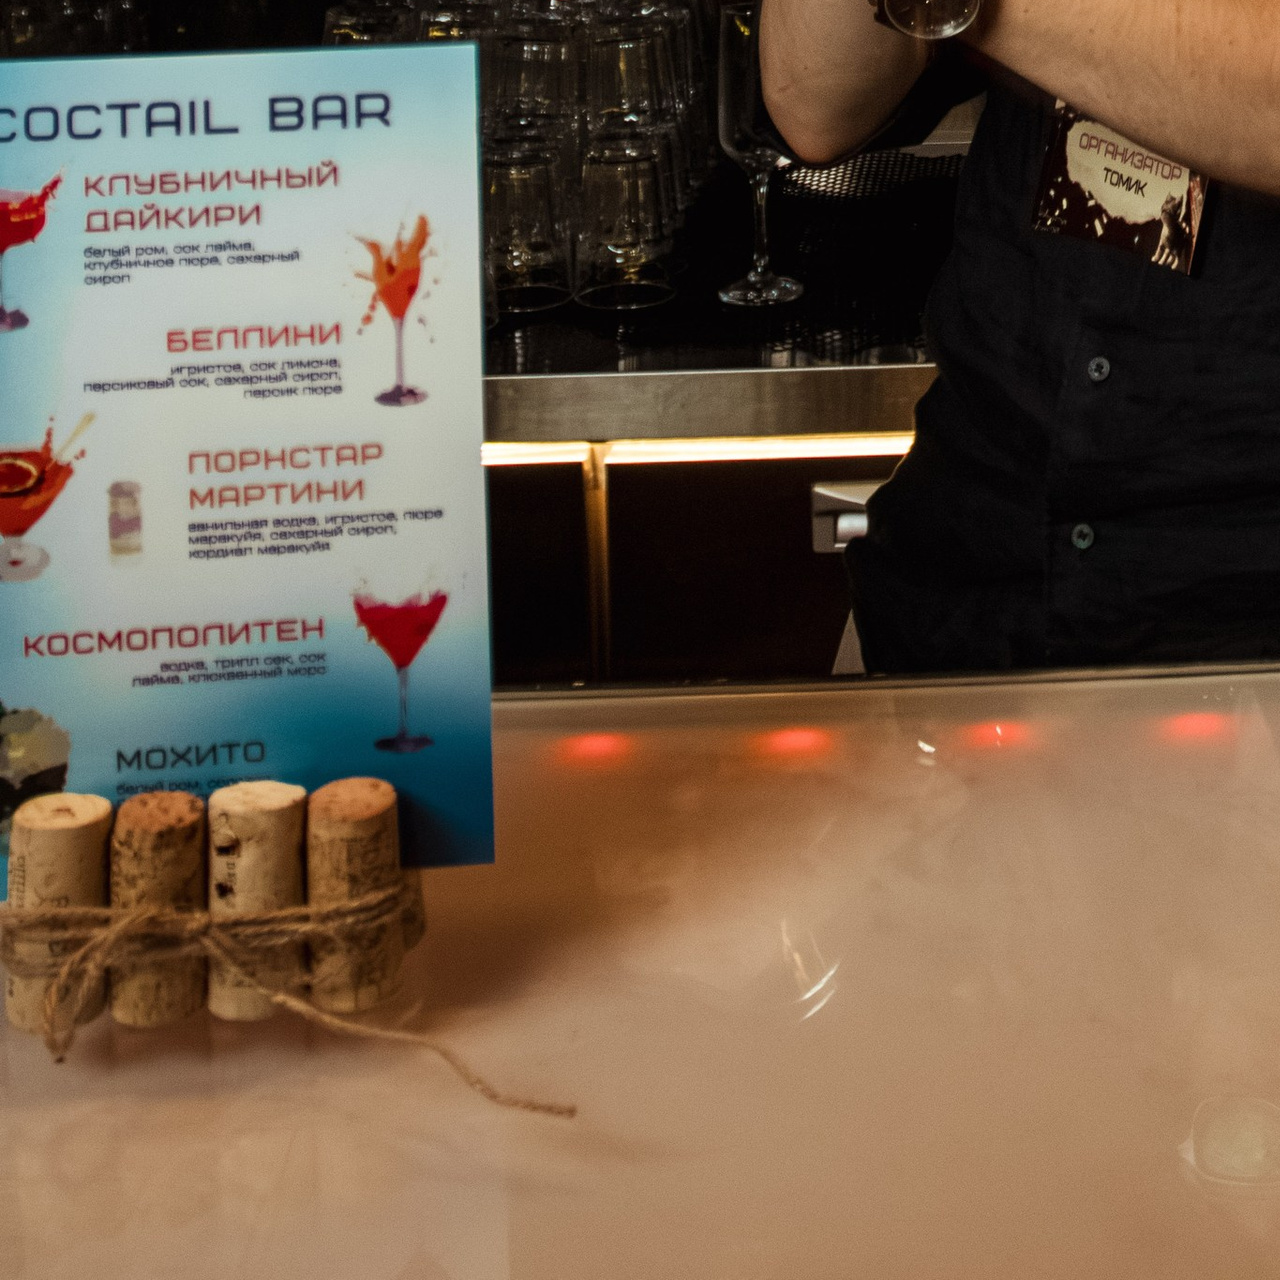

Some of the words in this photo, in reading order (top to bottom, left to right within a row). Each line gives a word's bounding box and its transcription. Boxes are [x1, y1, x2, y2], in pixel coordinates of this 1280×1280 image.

[268, 92, 392, 132] BAR
[1079, 132, 1182, 181] ОРГАНИЗАТОР
[84, 160, 339, 198] КЛУБНИЧНЫЙ
[1103, 167, 1148, 198] ТОМИК
[84, 204, 262, 233] ДАЙКИРИ
[83, 273, 131, 286] сироп
[166, 322, 342, 354] БЕЛЛИНИ
[188, 442, 384, 475] ПОРНСТАР
[189, 478, 365, 510] МАРТИНИ
[23, 617, 325, 658] КОСМОПОЛИТЕН
[116, 741, 266, 772] МОХИТО
